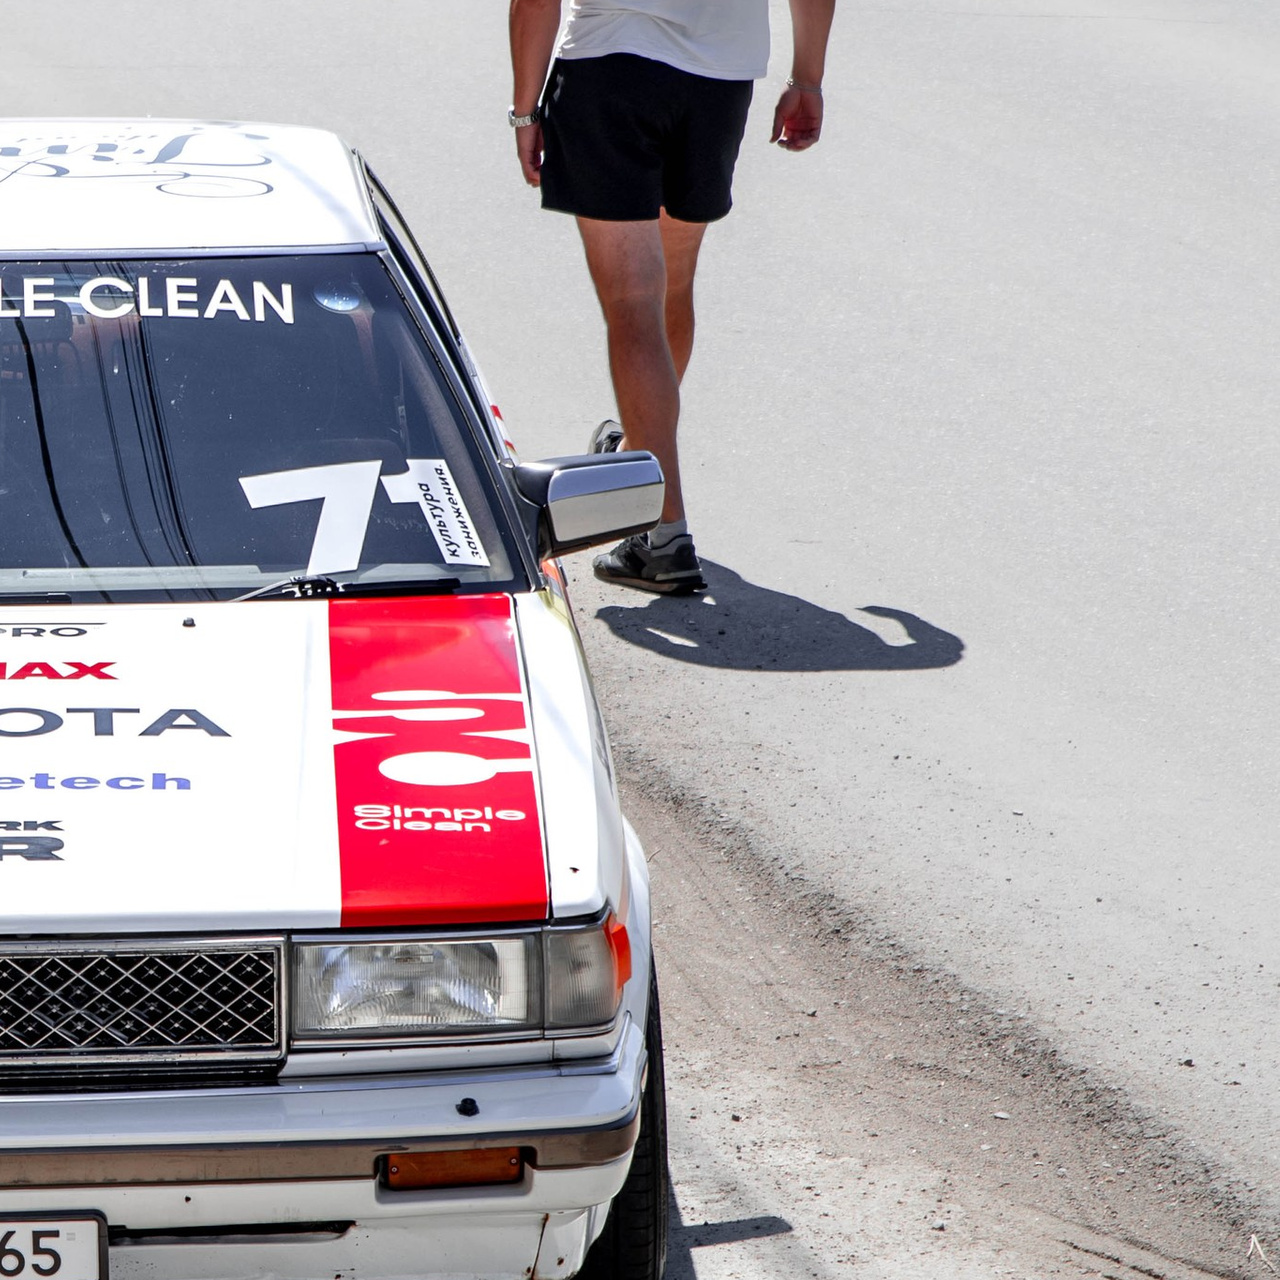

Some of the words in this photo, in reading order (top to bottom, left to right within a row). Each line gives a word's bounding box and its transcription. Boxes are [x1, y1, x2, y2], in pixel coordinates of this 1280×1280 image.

[79, 275, 296, 325] CLEAN
[417, 482, 460, 559] культура
[353, 803, 527, 821] Simple
[354, 818, 492, 833] Clean
